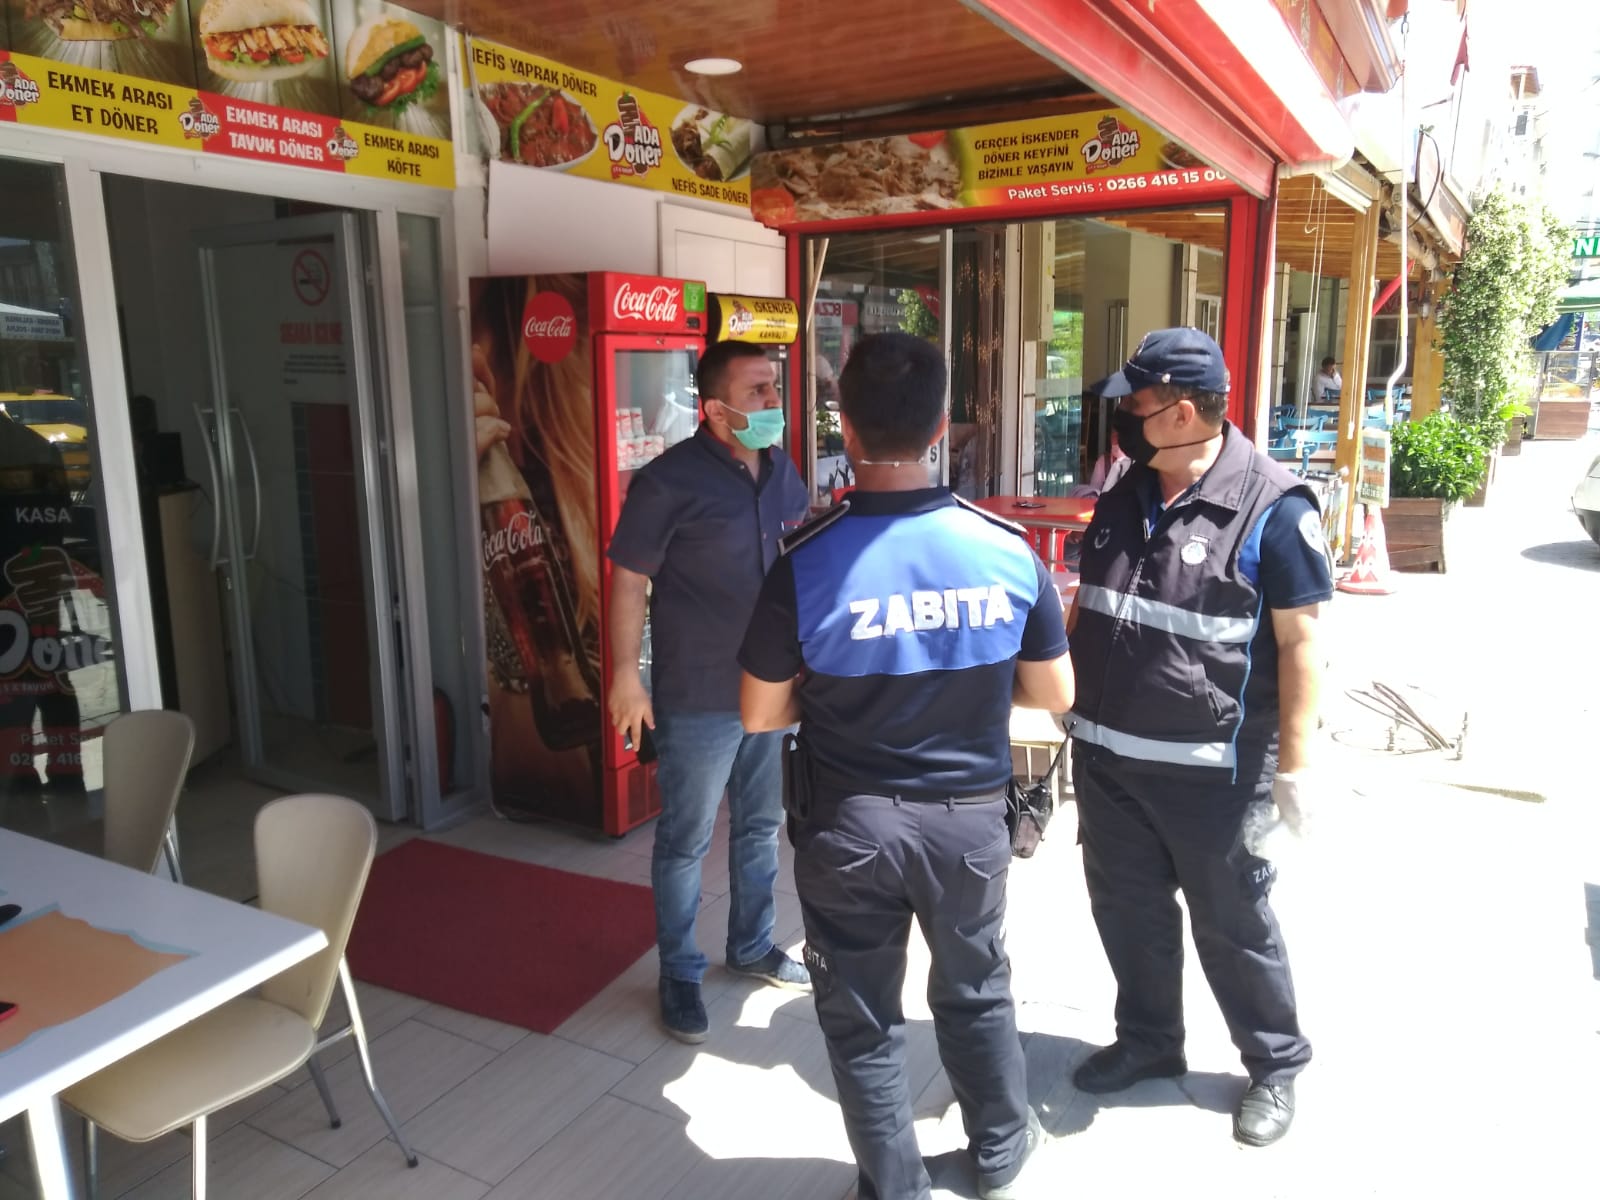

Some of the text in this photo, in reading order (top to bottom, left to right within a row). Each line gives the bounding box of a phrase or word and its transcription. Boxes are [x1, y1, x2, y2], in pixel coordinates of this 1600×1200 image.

[15, 78, 38, 92] ADA
[47, 71, 172, 109] EKMEK ARASI
[510, 59, 558, 84] YAPRAK
[562, 71, 597, 97] DÖNER
[71, 104, 158, 134] ET DÖNER
[200, 113, 218, 125] ADA
[226, 106, 322, 137] EKMEK ARASI
[229, 132, 323, 161] TAVUK DÖNER
[364, 132, 440, 160] EKMEK ARASI
[634, 125, 660, 147] ADA
[974, 128, 1079, 151] GERÇEK İSKENDER
[1112, 131, 1138, 145] ADA
[387, 156, 421, 177] KÖFTE
[983, 143, 1069, 165] DÖNER KEYFİNİ
[978, 164, 1023, 181] BİZİMLE
[1027, 161, 1074, 177] YAŞAYIN
[671, 176, 749, 205] NEFİS SADE DÖNER
[1008, 185, 1047, 201] Paket
[1051, 182, 1095, 197] Servis
[1106, 176, 1148, 192] 0266
[1151, 172, 1179, 187] 416
[1182, 170, 1200, 184] 15
[613, 282, 680, 323] Coca-Cola
[525, 315, 575, 338] Coca-Cola
[16, 507, 71, 523] KASA
[850, 585, 1015, 641] ZABITA
